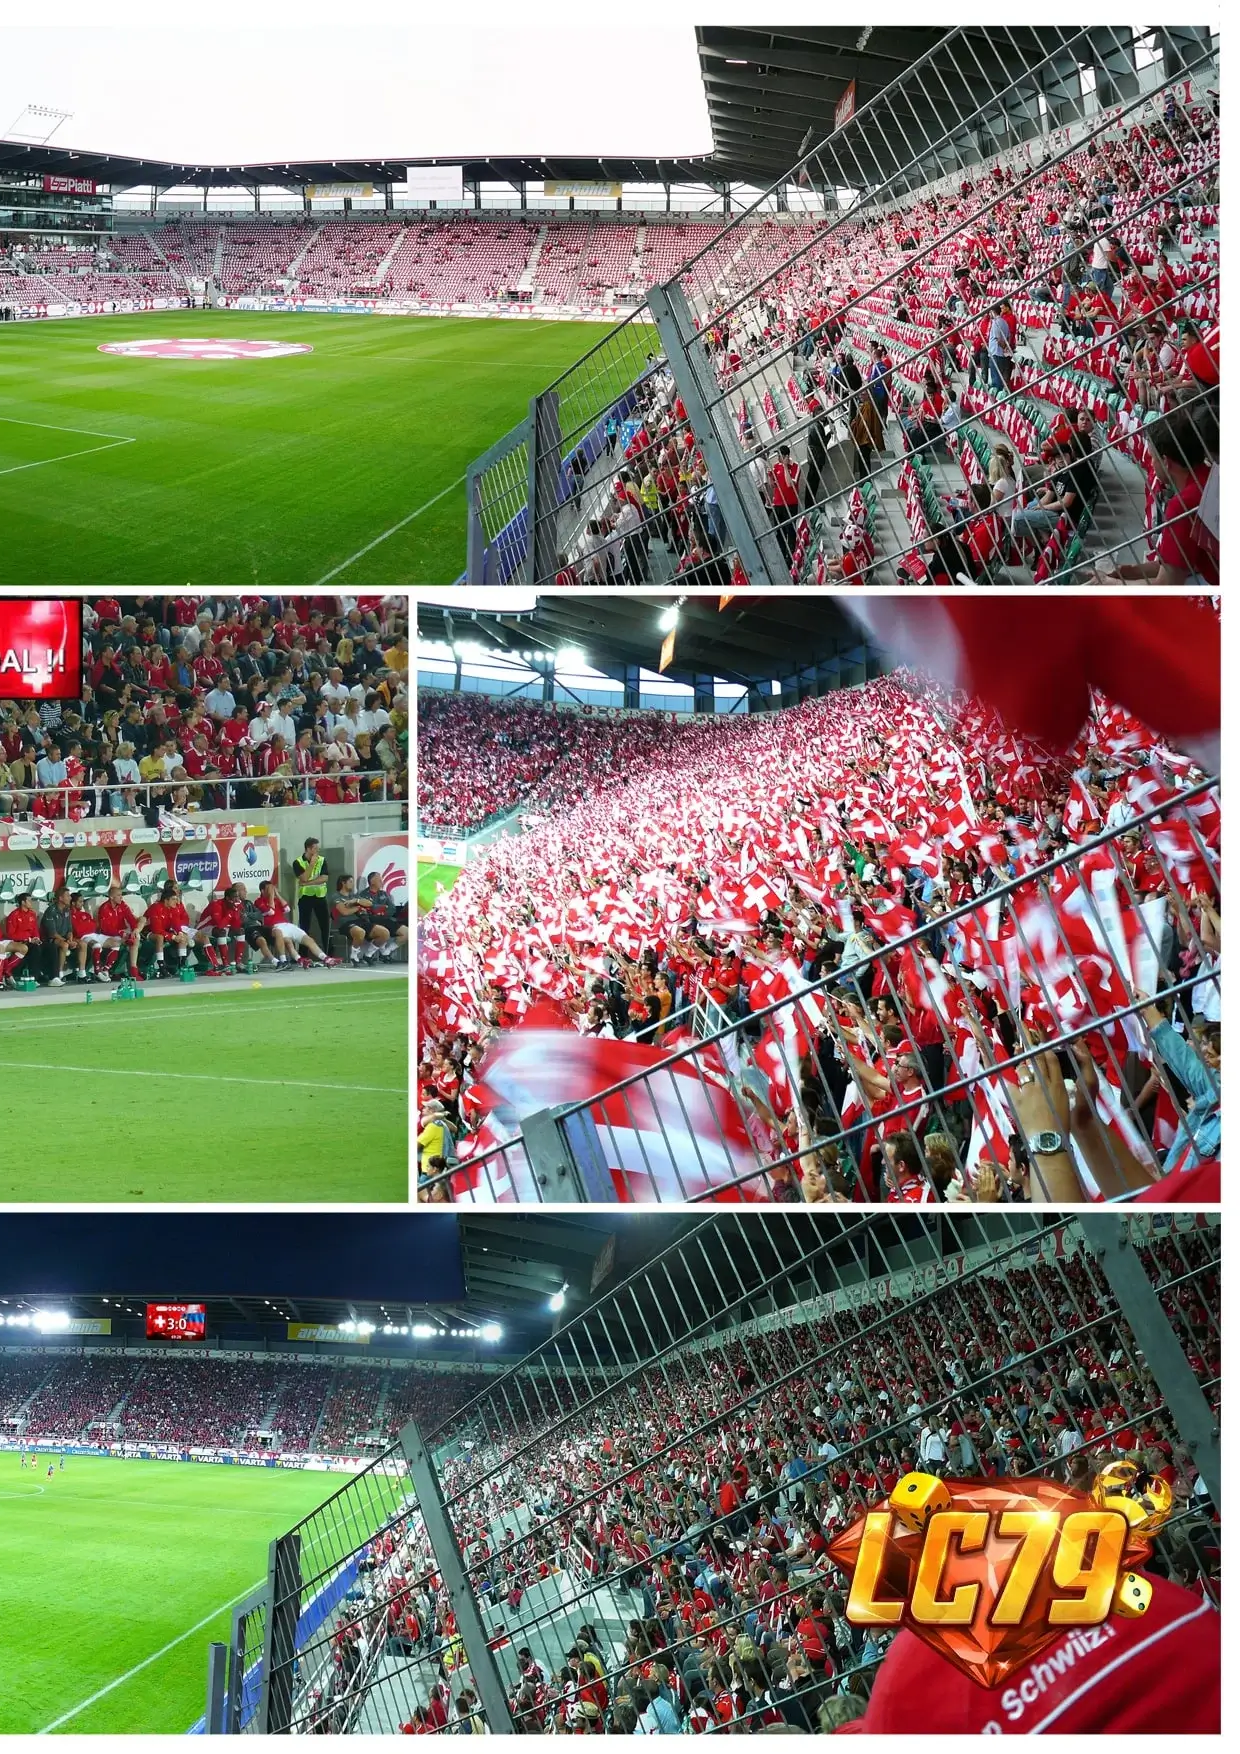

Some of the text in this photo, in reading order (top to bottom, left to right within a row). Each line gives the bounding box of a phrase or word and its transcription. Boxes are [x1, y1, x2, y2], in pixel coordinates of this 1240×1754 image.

[68, 177, 93, 193] Piatti
[46, 648, 64, 673] !!
[232, 867, 270, 879] swisscom
[167, 1317, 187, 1330] 3:0
[157, 1452, 182, 1460] VARTA
[198, 1455, 224, 1463] VARTA
[283, 1461, 305, 1469] VART
